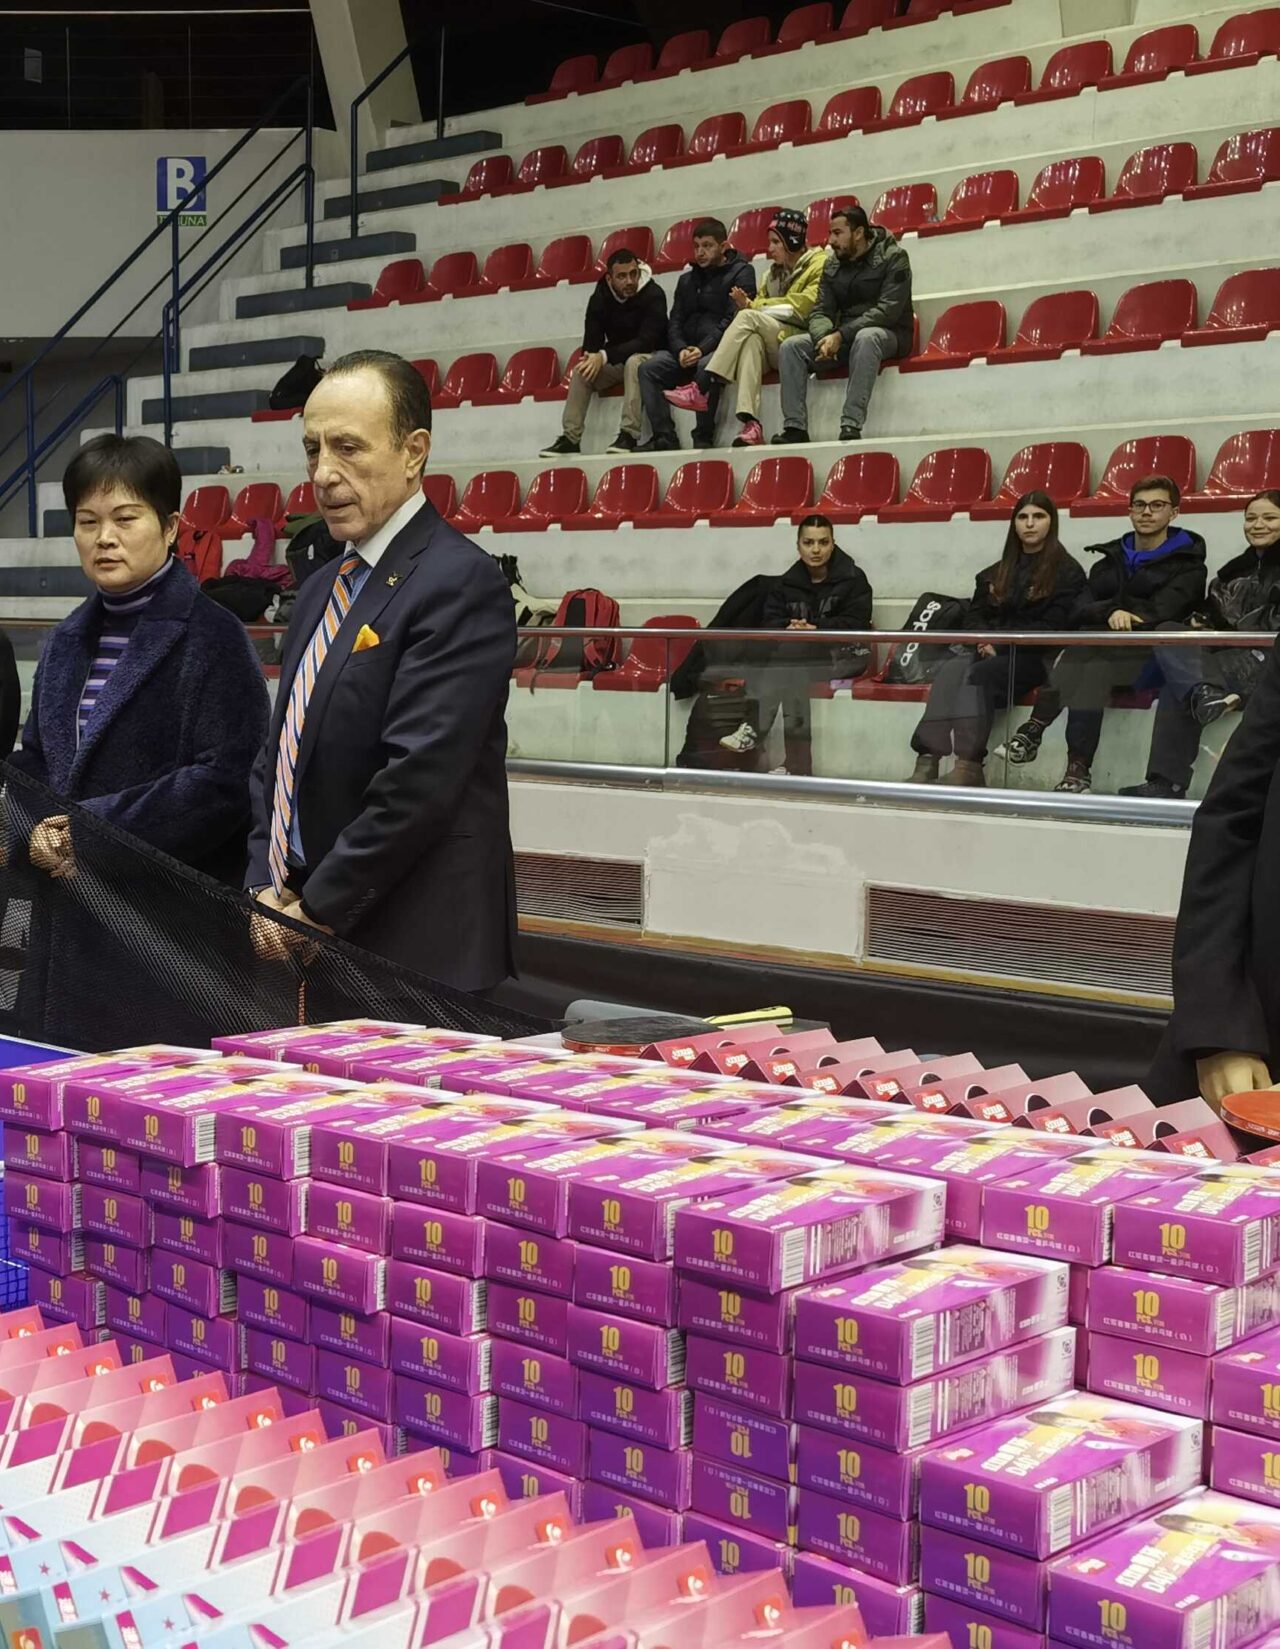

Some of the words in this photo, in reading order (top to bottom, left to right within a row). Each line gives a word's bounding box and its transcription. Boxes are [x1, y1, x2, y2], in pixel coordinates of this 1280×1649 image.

[167, 158, 198, 210] B
[12, 1083, 27, 1103] 10
[86, 1097, 100, 1117] 10
[144, 1115, 159, 1136] 10
[26, 1135, 39, 1155] 10
[241, 1127, 256, 1148] 10
[102, 1148, 116, 1168] 10
[338, 1142, 354, 1164] 10
[167, 1167, 183, 1188] 10
[419, 1159, 437, 1183] 10
[26, 1184, 39, 1205] 10
[248, 1184, 263, 1204] 10
[507, 1178, 526, 1201] 10
[104, 1198, 117, 1218] 10
[337, 1202, 352, 1224] 10
[602, 1200, 621, 1225] 10
[1024, 1205, 1049, 1231] 10
[28, 1227, 40, 1247] 10
[180, 1217, 193, 1238] 10
[424, 1221, 443, 1245] 10
[1159, 1223, 1186, 1249] 10
[102, 1244, 115, 1264] 10
[253, 1235, 267, 1256] 10
[519, 1241, 538, 1266] 10
[712, 1229, 733, 1256] 10
[172, 1264, 186, 1285] 10
[322, 1259, 337, 1280] 10
[610, 1267, 630, 1290] 10
[49, 1279, 62, 1299] 10
[263, 1288, 279, 1310] 10
[414, 1278, 432, 1302] 10
[128, 1297, 141, 1318] 10
[517, 1297, 536, 1322] 10
[719, 1290, 740, 1317] 10
[1133, 1290, 1160, 1317] 10
[191, 1319, 204, 1340] 10
[340, 1315, 355, 1336] 10
[835, 1317, 858, 1345] 10
[420, 1337, 439, 1359] 10
[601, 1326, 620, 1351] 10
[130, 1344, 143, 1362] 10
[271, 1341, 285, 1361] 10
[522, 1359, 541, 1383] 10
[724, 1352, 744, 1378] 10
[1133, 1354, 1160, 1381] 10
[345, 1367, 360, 1387] 10
[424, 1392, 442, 1415] 10
[614, 1387, 633, 1412] 10
[833, 1383, 856, 1411] 10
[530, 1417, 549, 1440] 10
[730, 1431, 752, 1458] 10
[624, 1447, 644, 1471] 10
[837, 1449, 860, 1478] 10
[521, 1474, 538, 1497] 10
[730, 1492, 752, 1519] 10
[963, 1483, 990, 1514] 10
[837, 1513, 860, 1542] 10
[718, 1539, 740, 1567] 10
[964, 1552, 990, 1583] 10
[1097, 1599, 1127, 1632] 10
[966, 1622, 992, 1649] 10
